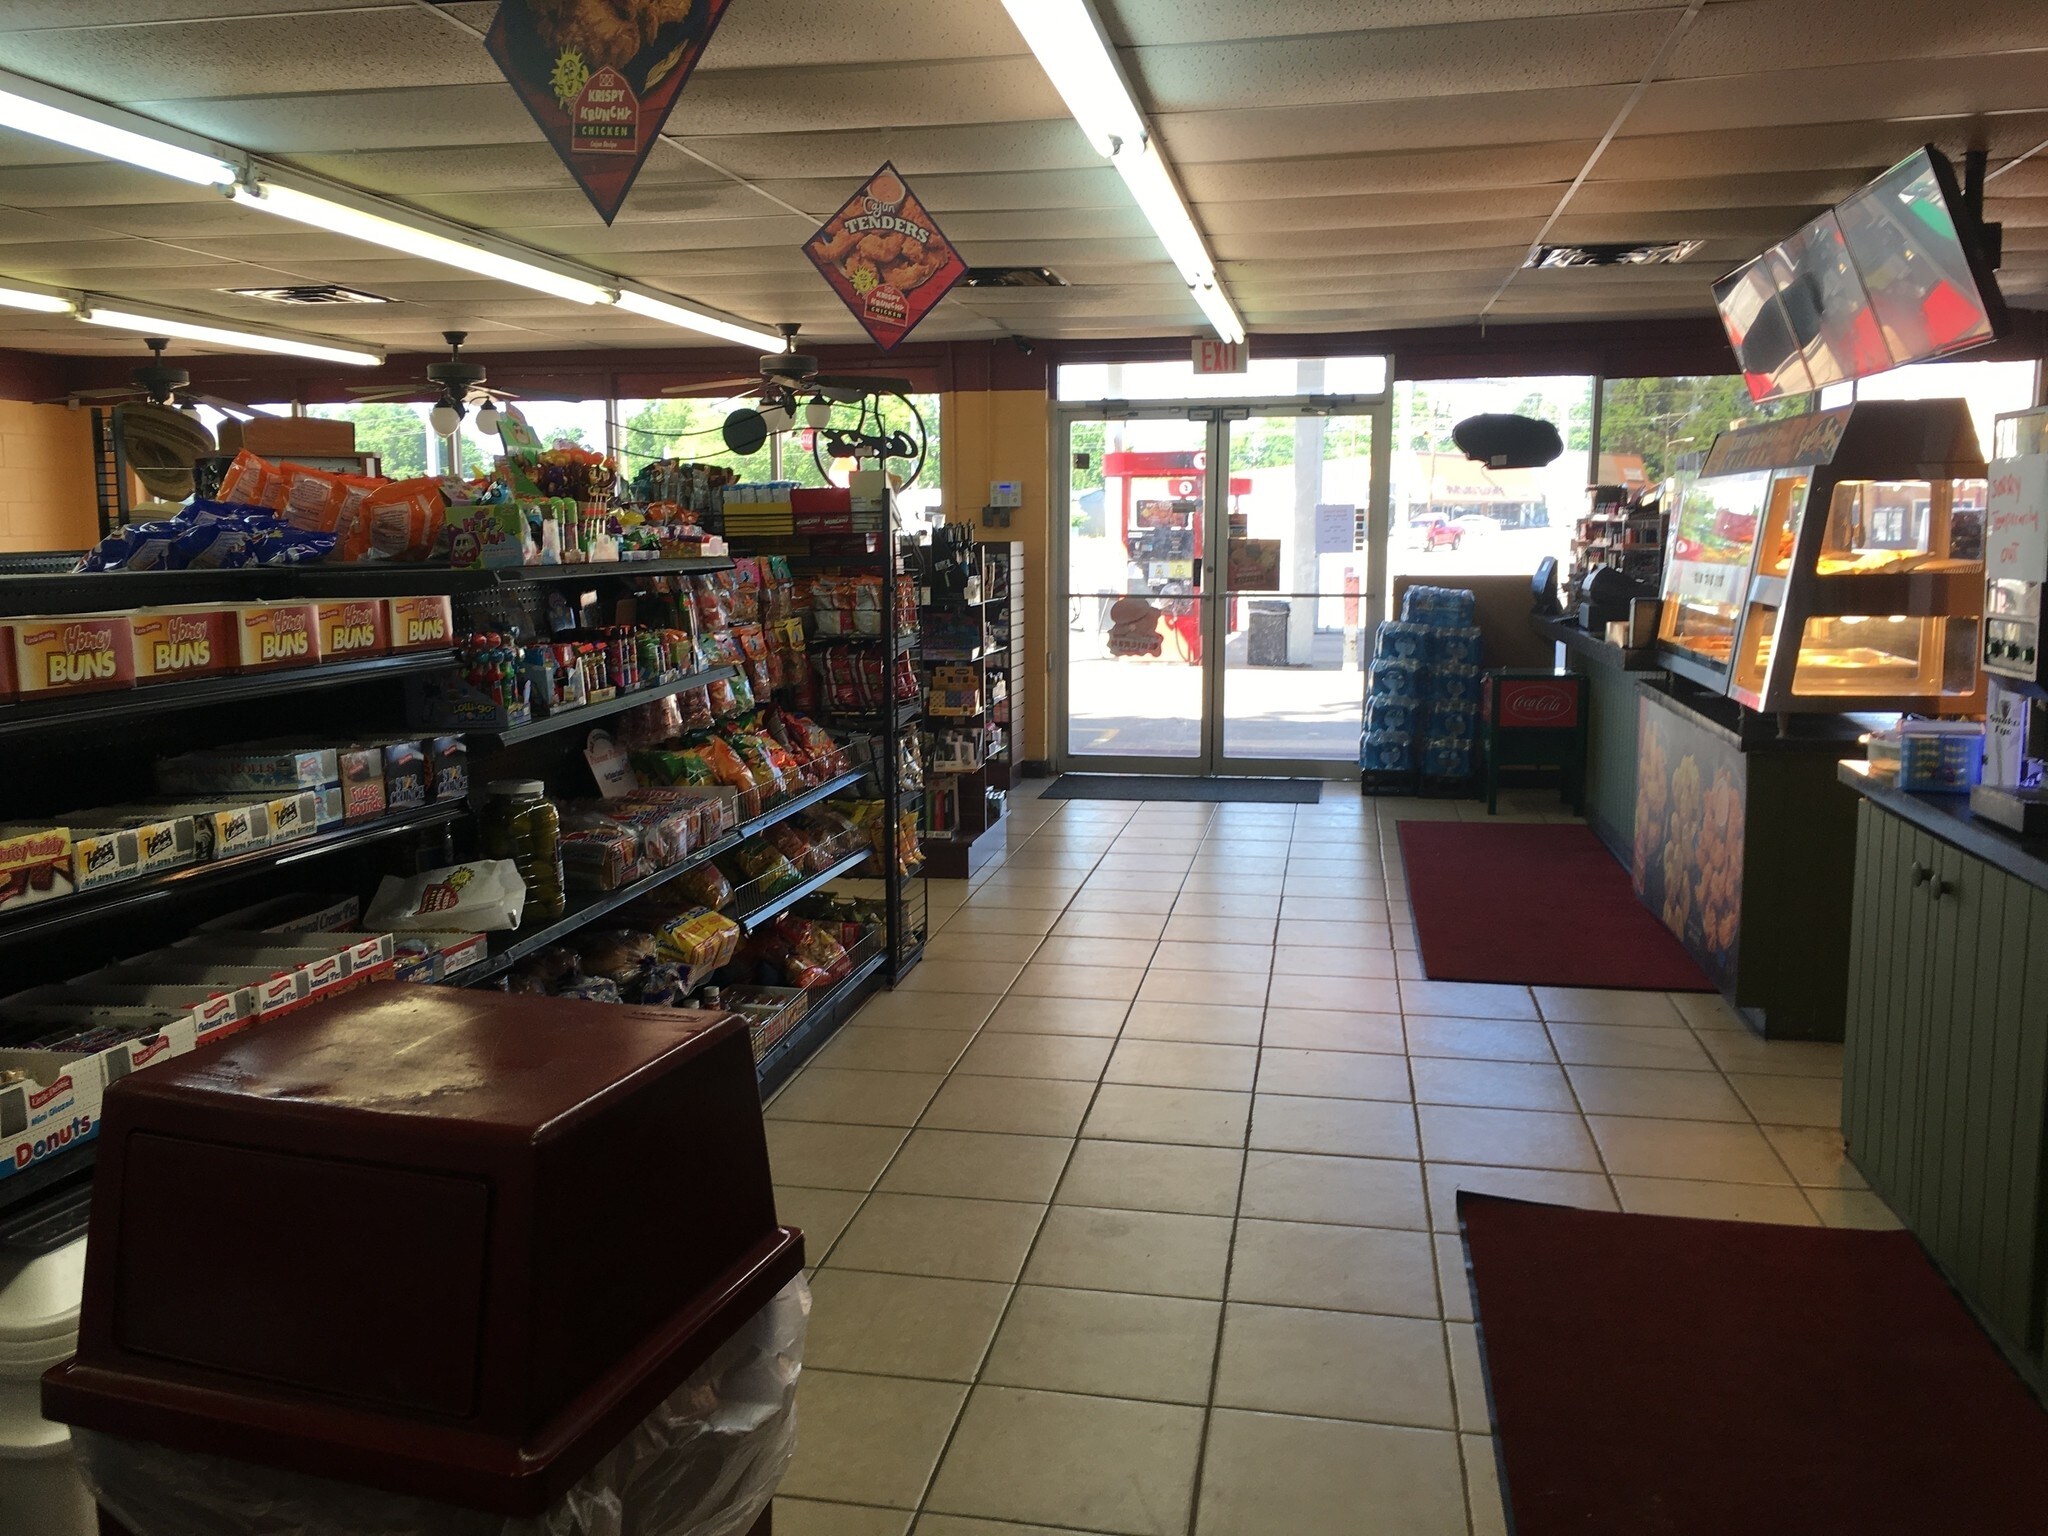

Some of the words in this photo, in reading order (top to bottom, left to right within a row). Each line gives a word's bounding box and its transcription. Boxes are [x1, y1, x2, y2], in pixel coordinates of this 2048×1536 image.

[588, 89, 625, 102] KRISPY
[580, 105, 632, 121] KRUNCHY
[581, 126, 628, 136] CHICKEN
[863, 196, 895, 217] Cajun
[844, 215, 929, 243] TENDERS
[870, 306, 902, 318] CHICKEN
[343, 604, 372, 627] Honey
[418, 599, 440, 619] Honey
[168, 617, 207, 645] Honey
[273, 610, 305, 634] Honey
[408, 618, 443, 641] BUNS
[63, 625, 111, 655] Honey
[262, 632, 308, 658] BUNS
[332, 624, 374, 649] BUNS
[49, 651, 116, 682] BUNS
[155, 641, 210, 670] BUNS
[350, 783, 379, 801] Fudge
[16, 1115, 91, 1168] Donuts
